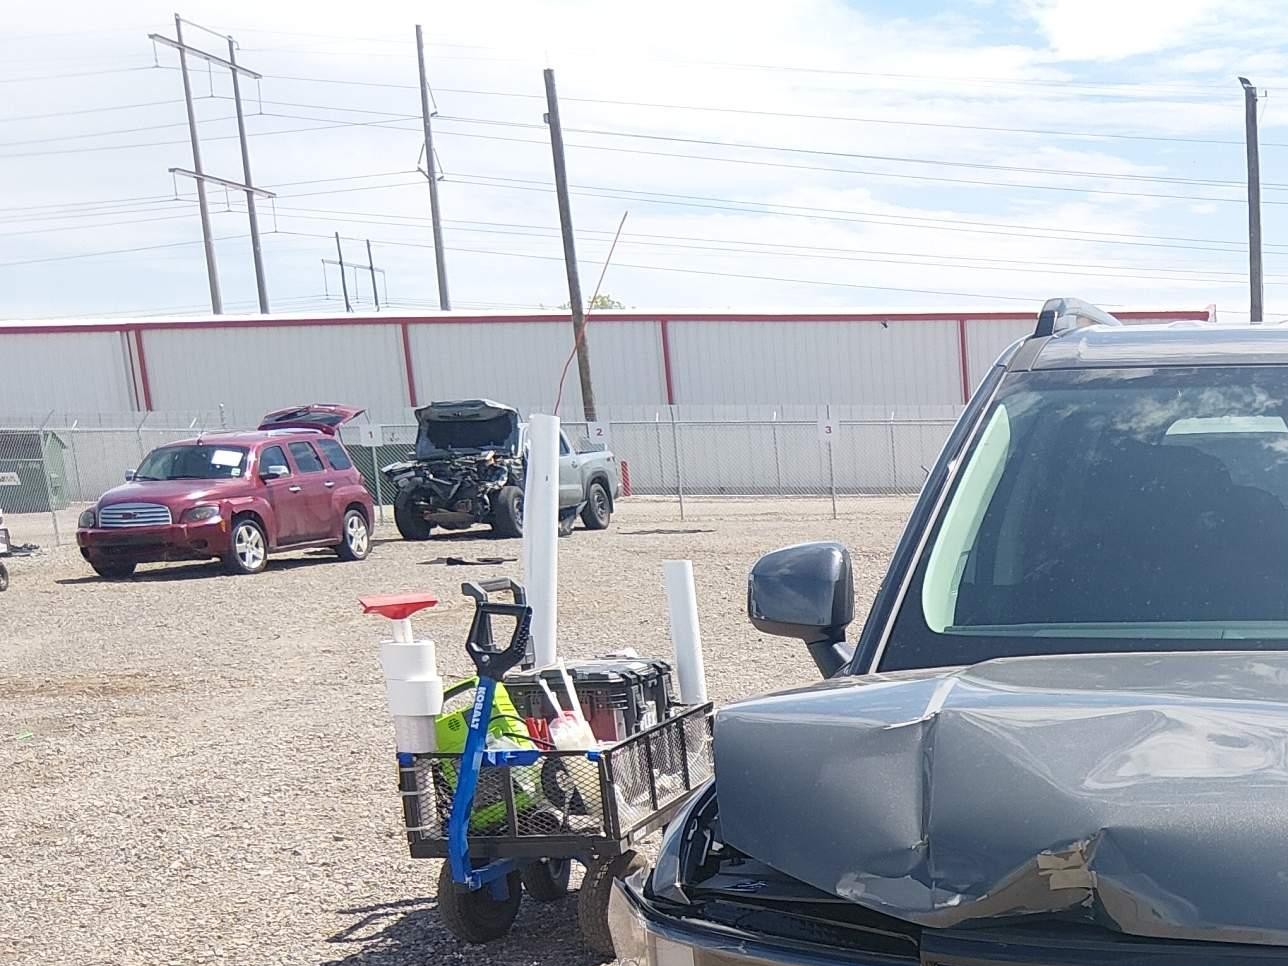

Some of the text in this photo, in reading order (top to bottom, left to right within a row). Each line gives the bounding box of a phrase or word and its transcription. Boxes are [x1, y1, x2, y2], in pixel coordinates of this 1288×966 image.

[595, 428, 603, 436] 2
[824, 425, 832, 434] 3
[470, 686, 487, 730] KOBALT
